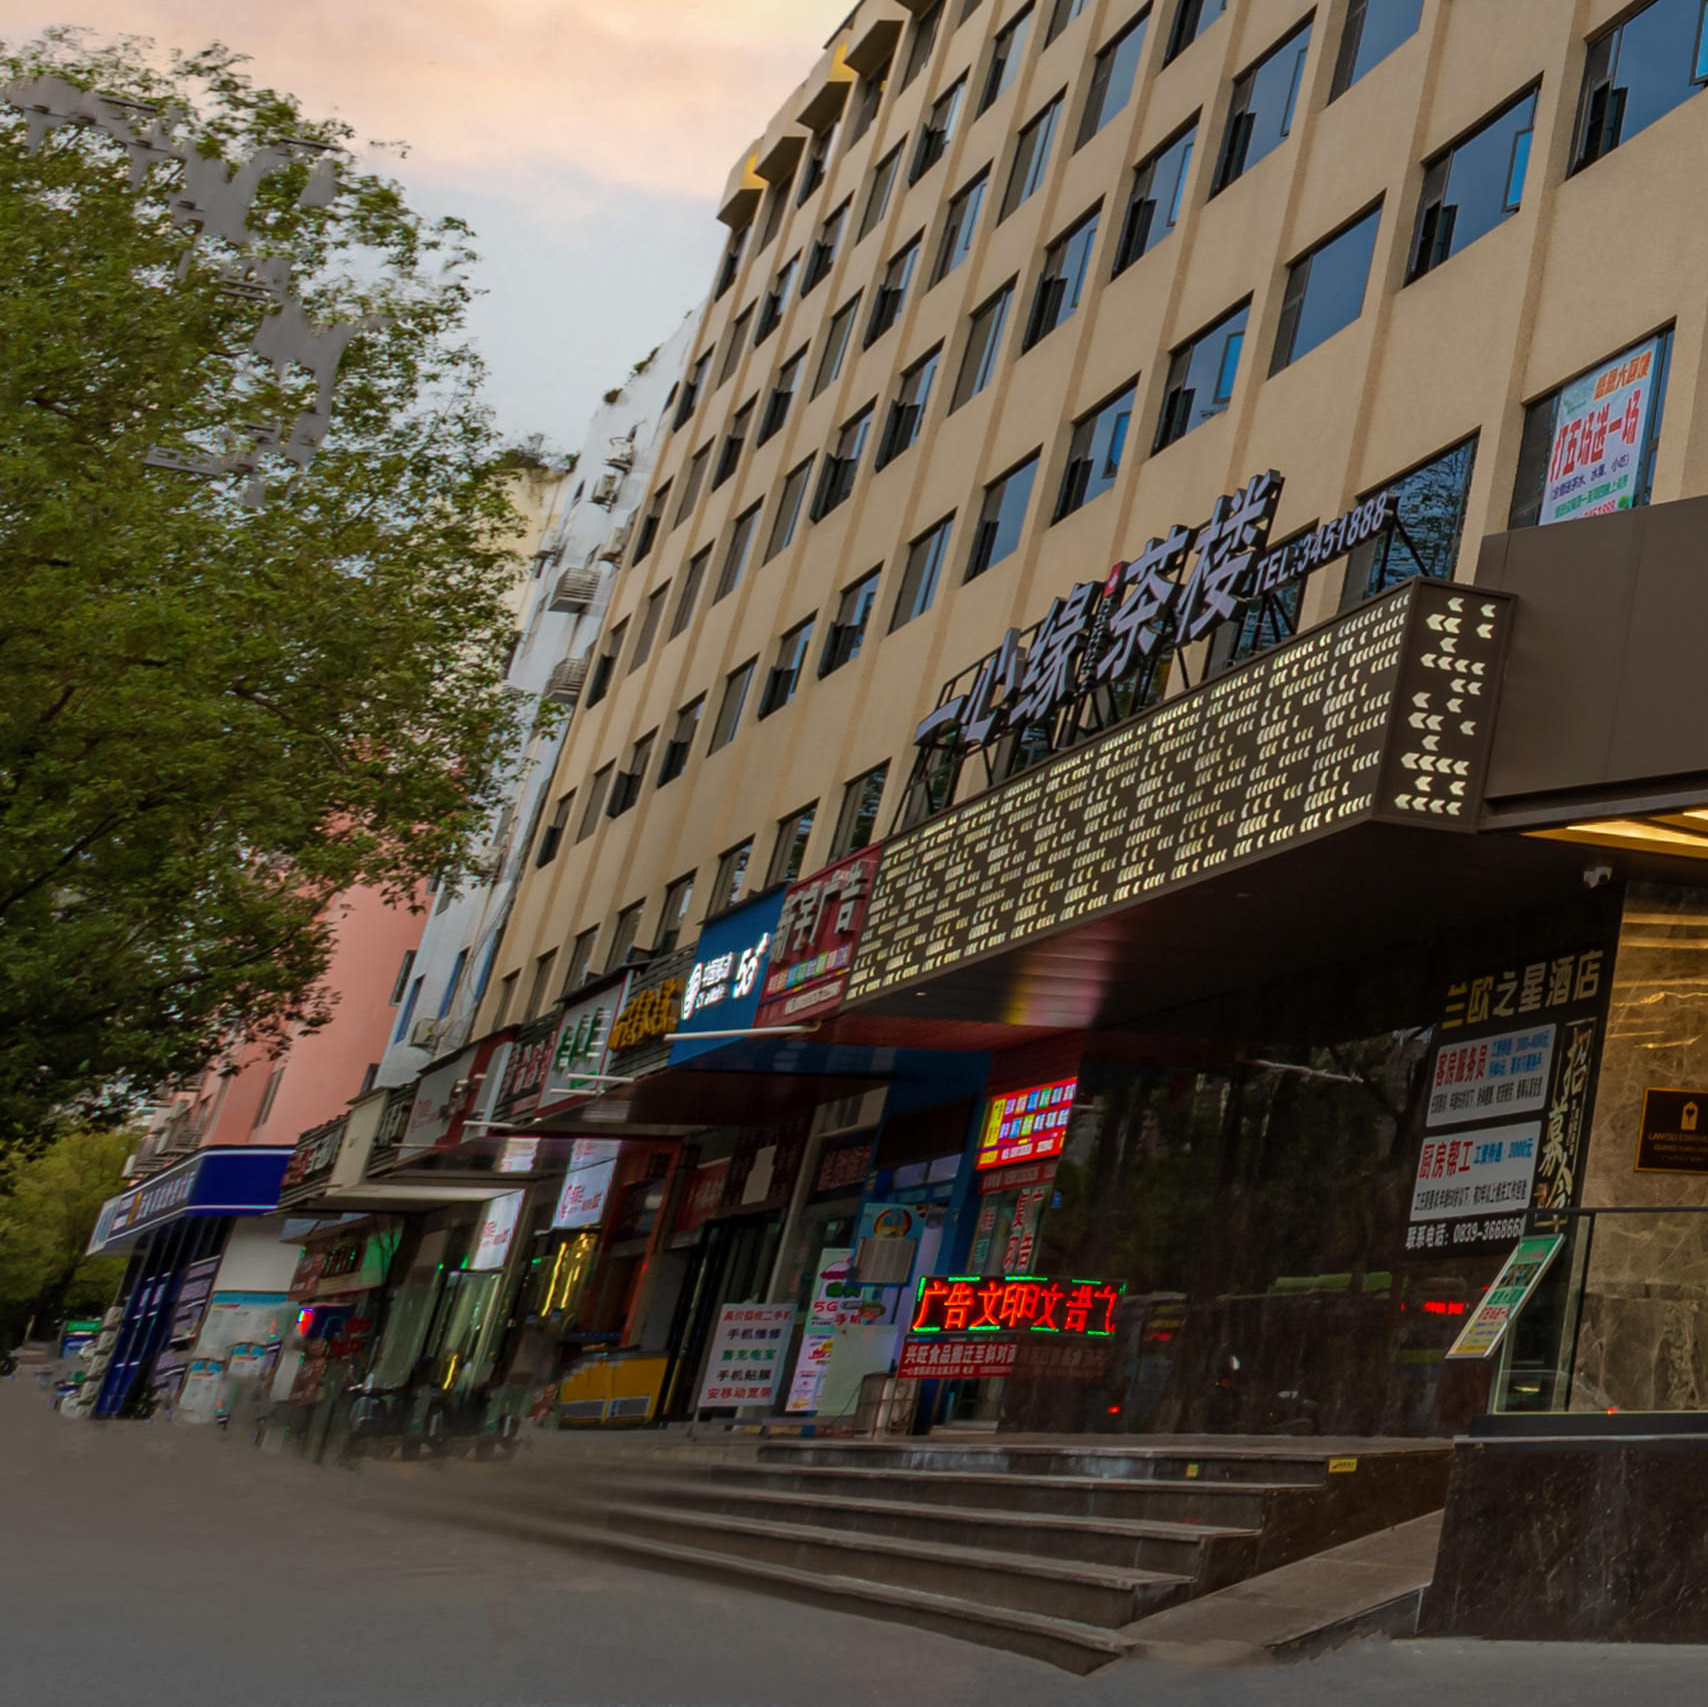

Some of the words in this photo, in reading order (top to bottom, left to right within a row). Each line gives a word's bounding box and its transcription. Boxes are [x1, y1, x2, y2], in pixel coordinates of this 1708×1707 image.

[1549, 389, 1641, 483] 打五场送一场
[1254, 490, 1395, 596] TEL:3451888
[914, 468, 1283, 745] 一心缘茶楼
[1441, 949, 1603, 1030] 兰欧之星酒店
[1435, 1044, 1488, 1088] 客房服务员
[1419, 1140, 1474, 1180] 厨房帮工
[813, 1301, 838, 1313] 5G
[727, 1328, 782, 1341] 手机维修
[707, 1387, 773, 1400] 安移动宽带
[717, 1369, 772, 1381] 手机贴膜
